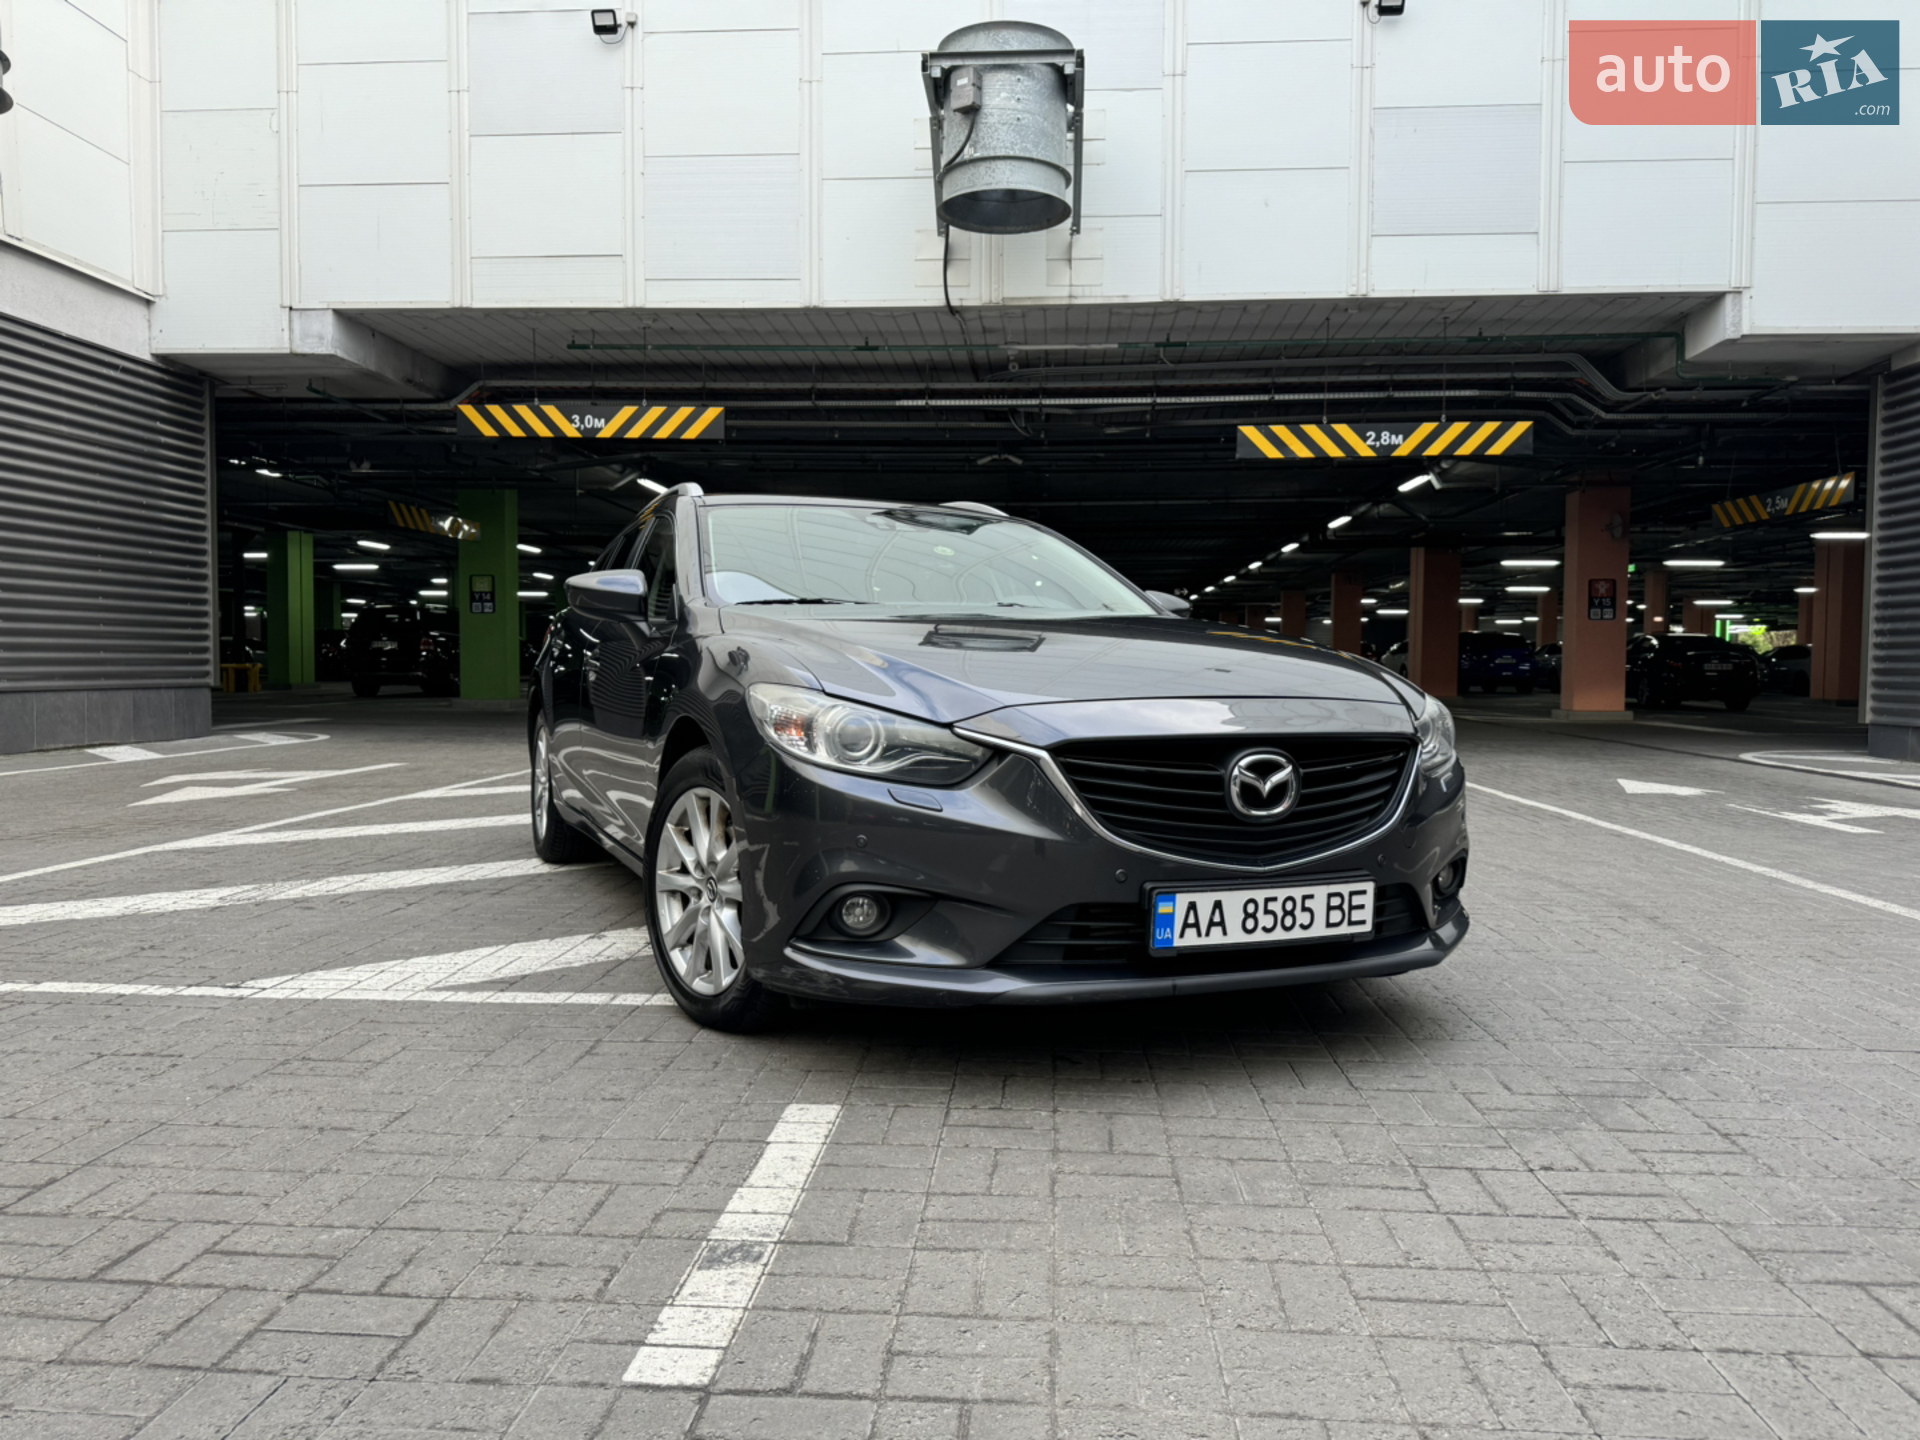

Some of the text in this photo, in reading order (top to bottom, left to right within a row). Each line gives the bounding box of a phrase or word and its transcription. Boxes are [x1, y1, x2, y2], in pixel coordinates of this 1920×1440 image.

[1178, 889, 1368, 939] AA 8585 BE
[1156, 927, 1172, 940] UA
